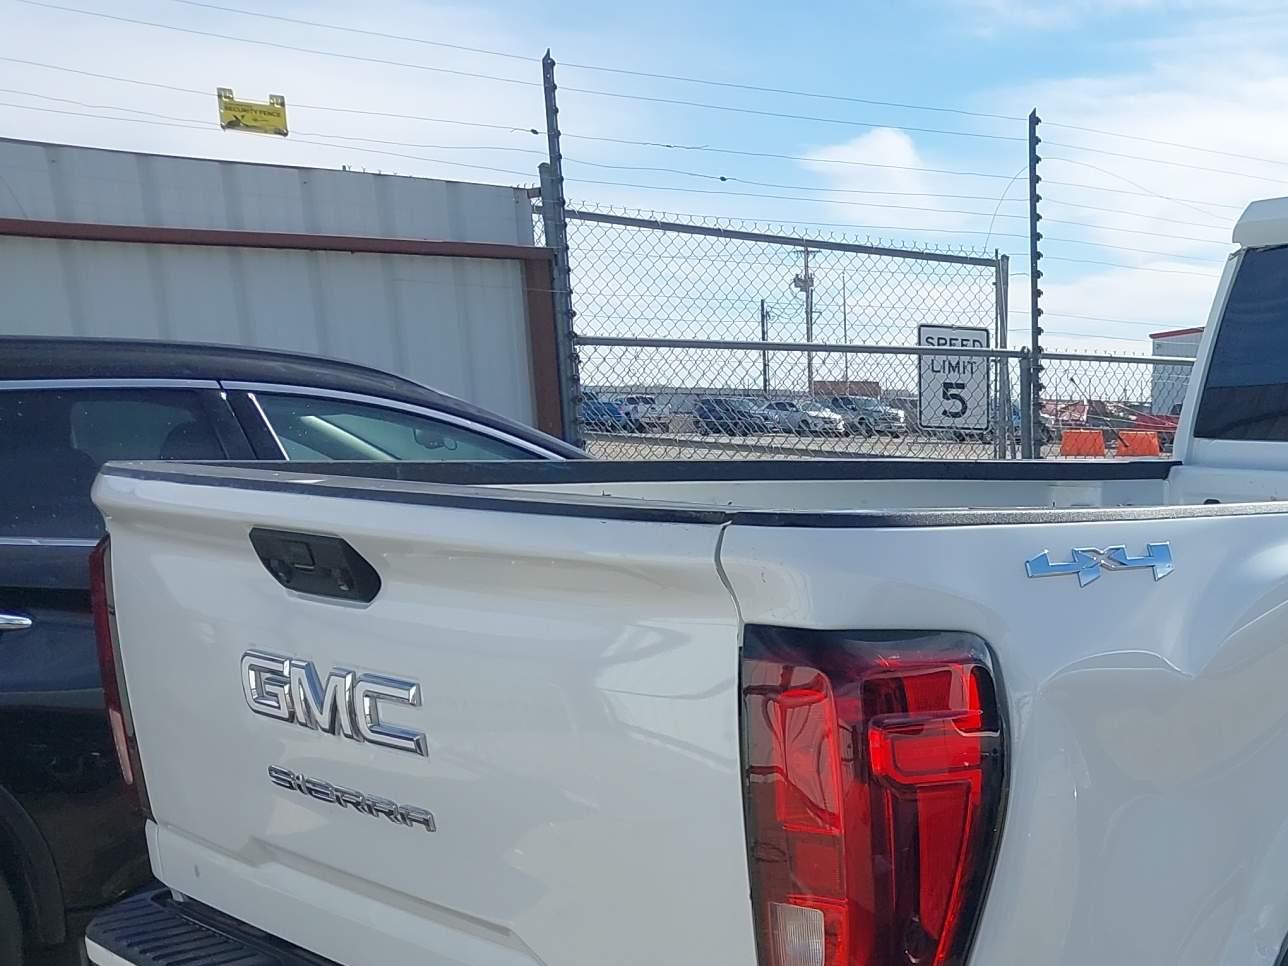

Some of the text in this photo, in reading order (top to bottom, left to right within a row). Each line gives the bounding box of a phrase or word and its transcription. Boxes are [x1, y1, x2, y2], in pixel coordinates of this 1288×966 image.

[925, 336, 984, 348] SPEED
[931, 359, 976, 375] LIMIT
[942, 382, 967, 418] 5
[240, 648, 429, 757] GMC
[267, 763, 437, 833] SIERRA
